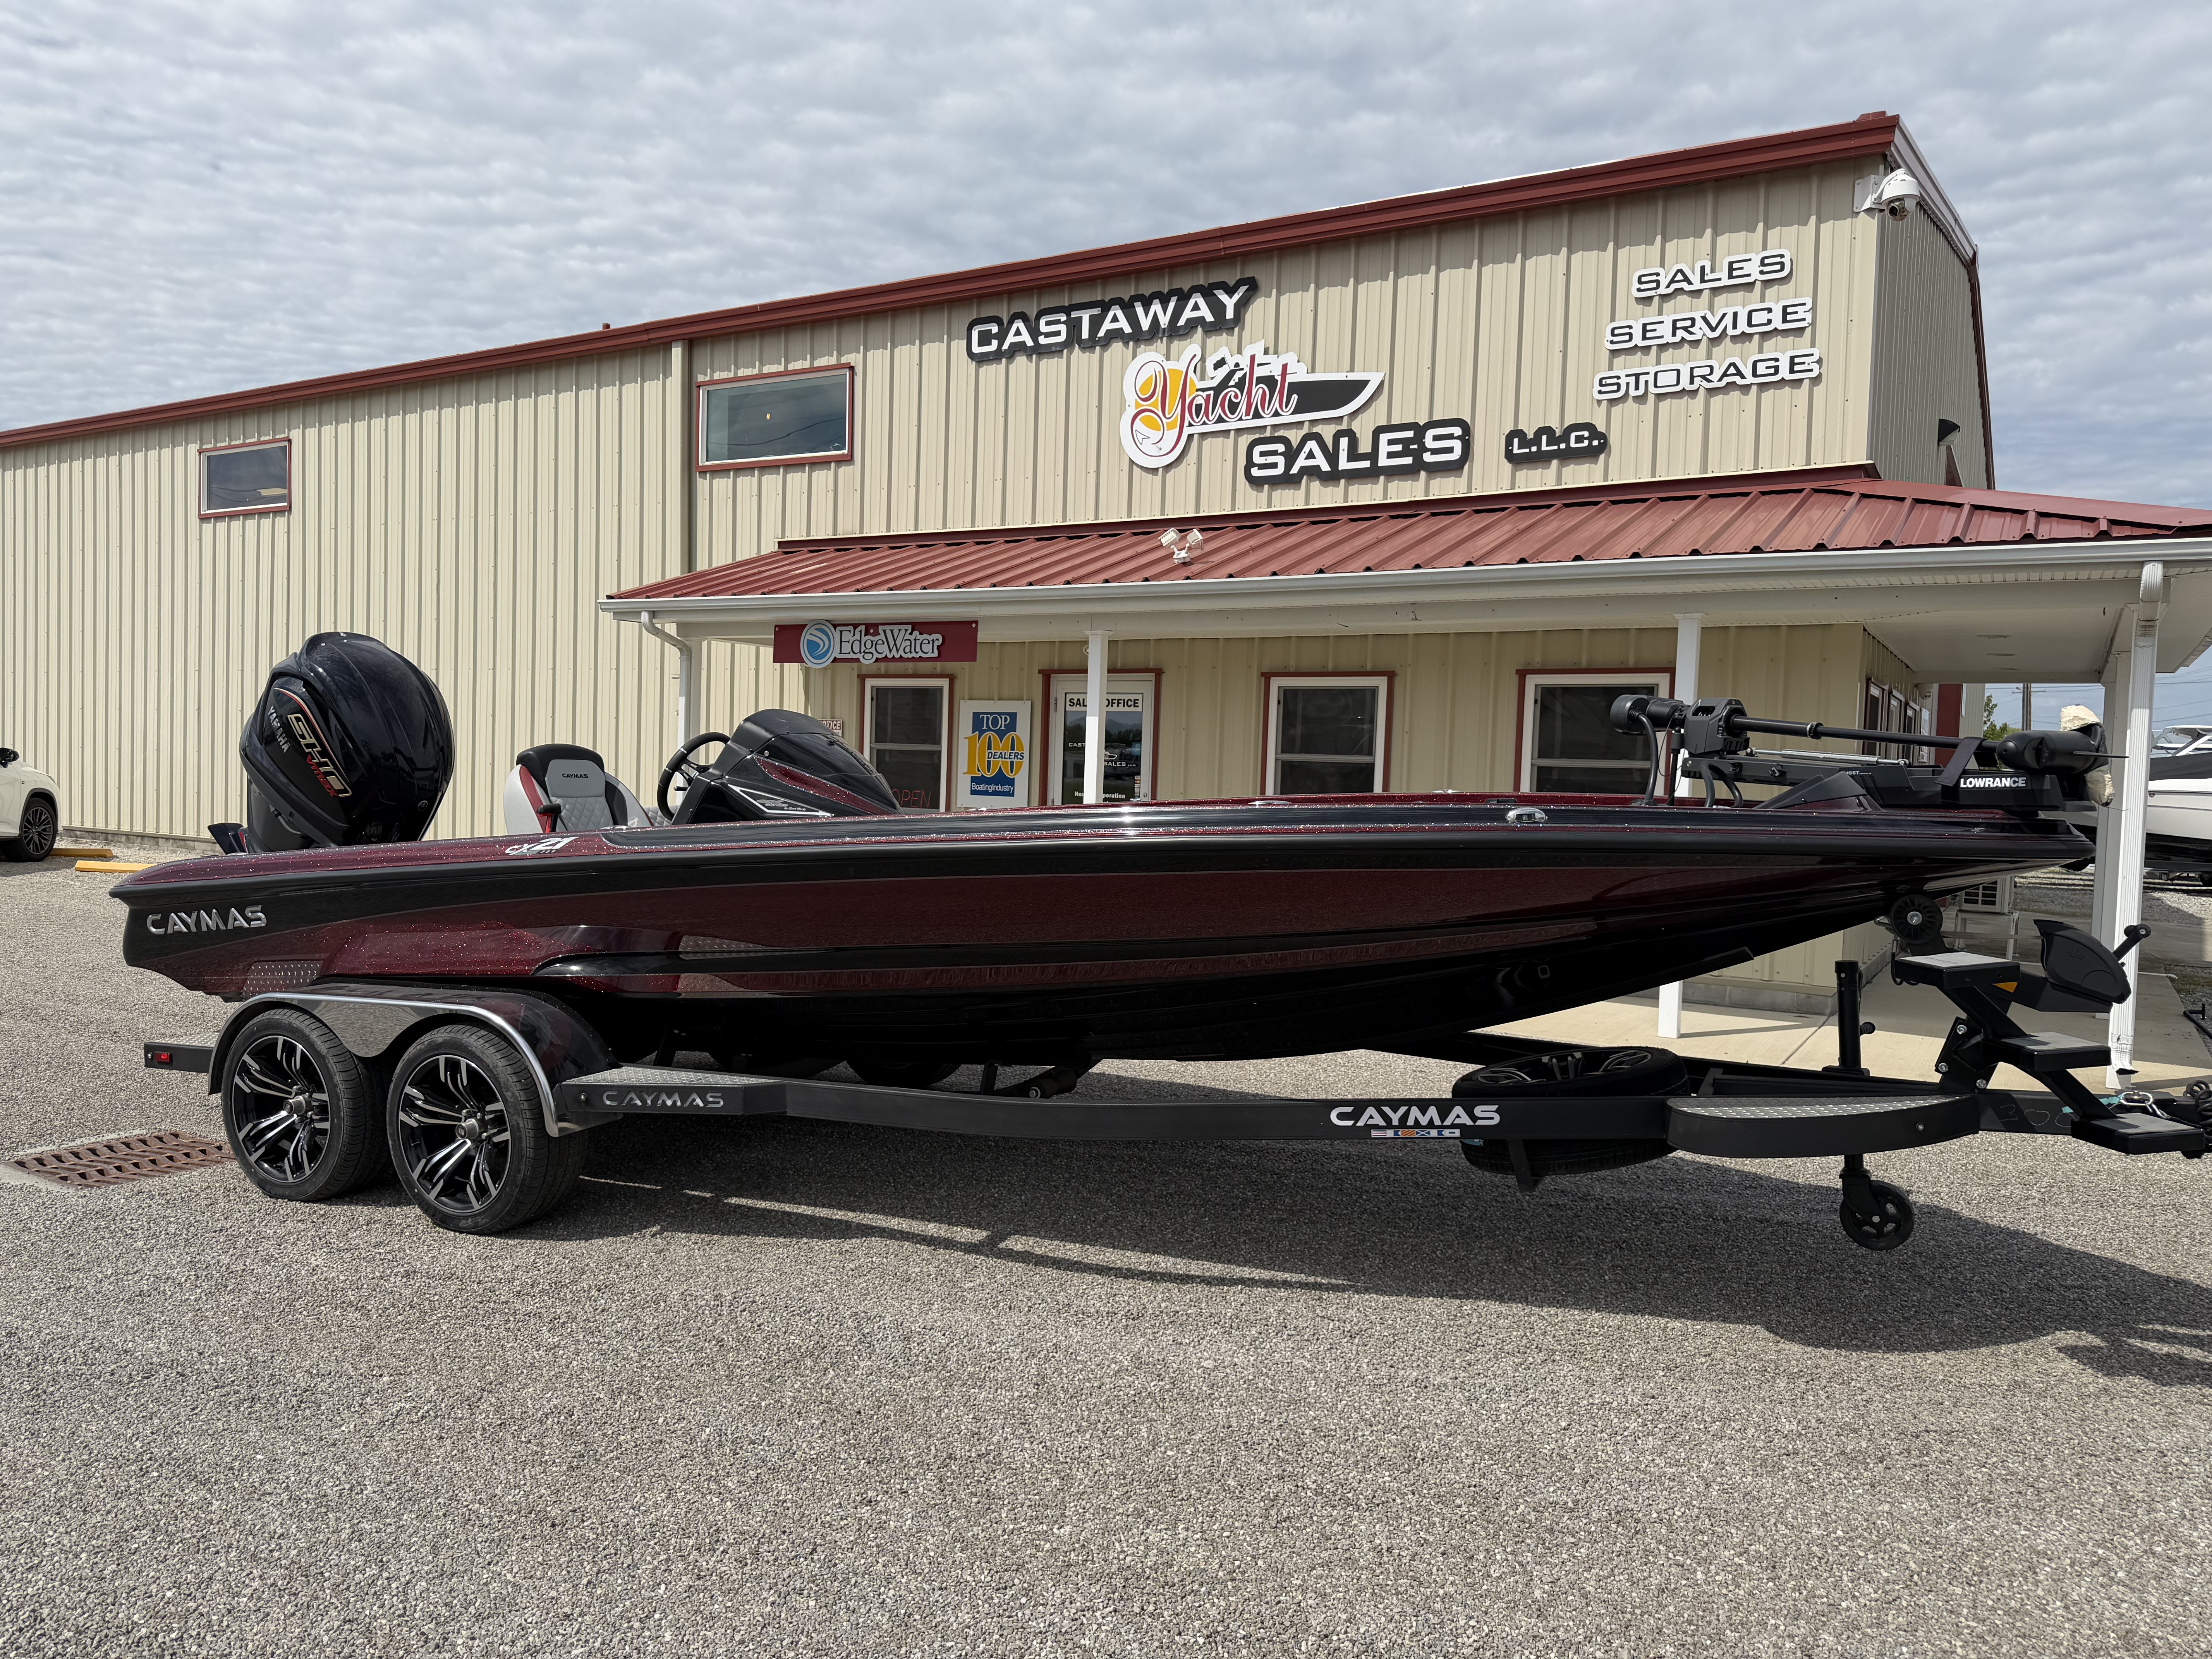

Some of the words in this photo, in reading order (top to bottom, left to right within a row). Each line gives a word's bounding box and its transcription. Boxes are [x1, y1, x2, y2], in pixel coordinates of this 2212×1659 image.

[1637, 253, 1787, 293] SALES
[970, 284, 1250, 355] CASTAWAY
[1609, 302, 1808, 345] SERVICE
[1596, 353, 1815, 395] STORAGE
[1130, 354, 1297, 457] Yacht
[1250, 426, 1462, 477] SALES
[1512, 429, 1600, 454] L.L.C.
[838, 628, 940, 660] EdgeWater
[1069, 698, 1087, 707] SAL
[268, 705, 290, 753] YAMAHA
[979, 714, 1010, 730] TOP
[287, 714, 352, 797] SHO
[963, 732, 1024, 778] 100
[987, 750, 1024, 761] DEALERS
[971, 782, 1014, 793] BoatingIndustry
[1960, 776, 2027, 788] LOWRANCE
[892, 789, 931, 808] OPEN
[146, 904, 267, 935] CAYMAS
[602, 1091, 724, 1108] CAYMAS
[1330, 1105, 1500, 1126] CAYMAS
